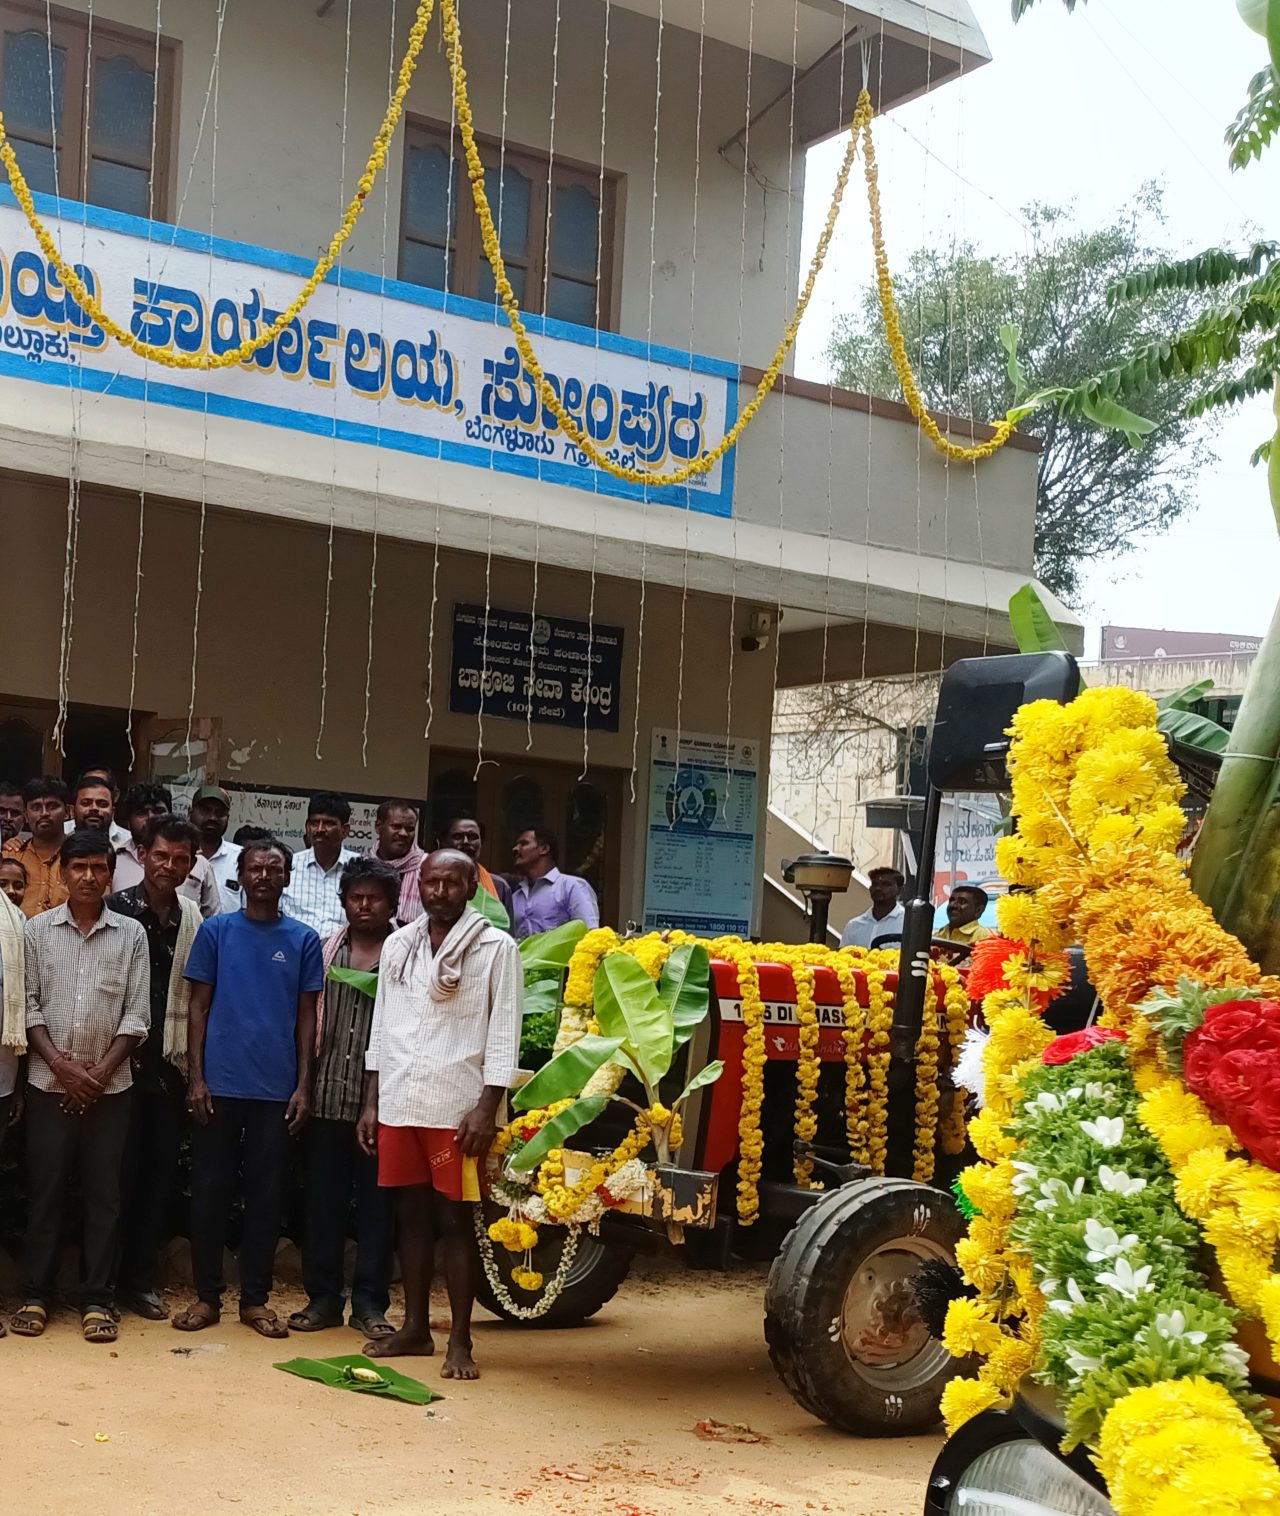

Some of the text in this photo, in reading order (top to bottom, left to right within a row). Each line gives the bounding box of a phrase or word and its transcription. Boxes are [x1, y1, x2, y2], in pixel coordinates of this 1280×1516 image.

[465, 417, 555, 456] ಬೆಂಗಳೂರು
[570, 677, 613, 716] ಕೇಂದ್ರ
[777, 1006, 793, 1021] DI
